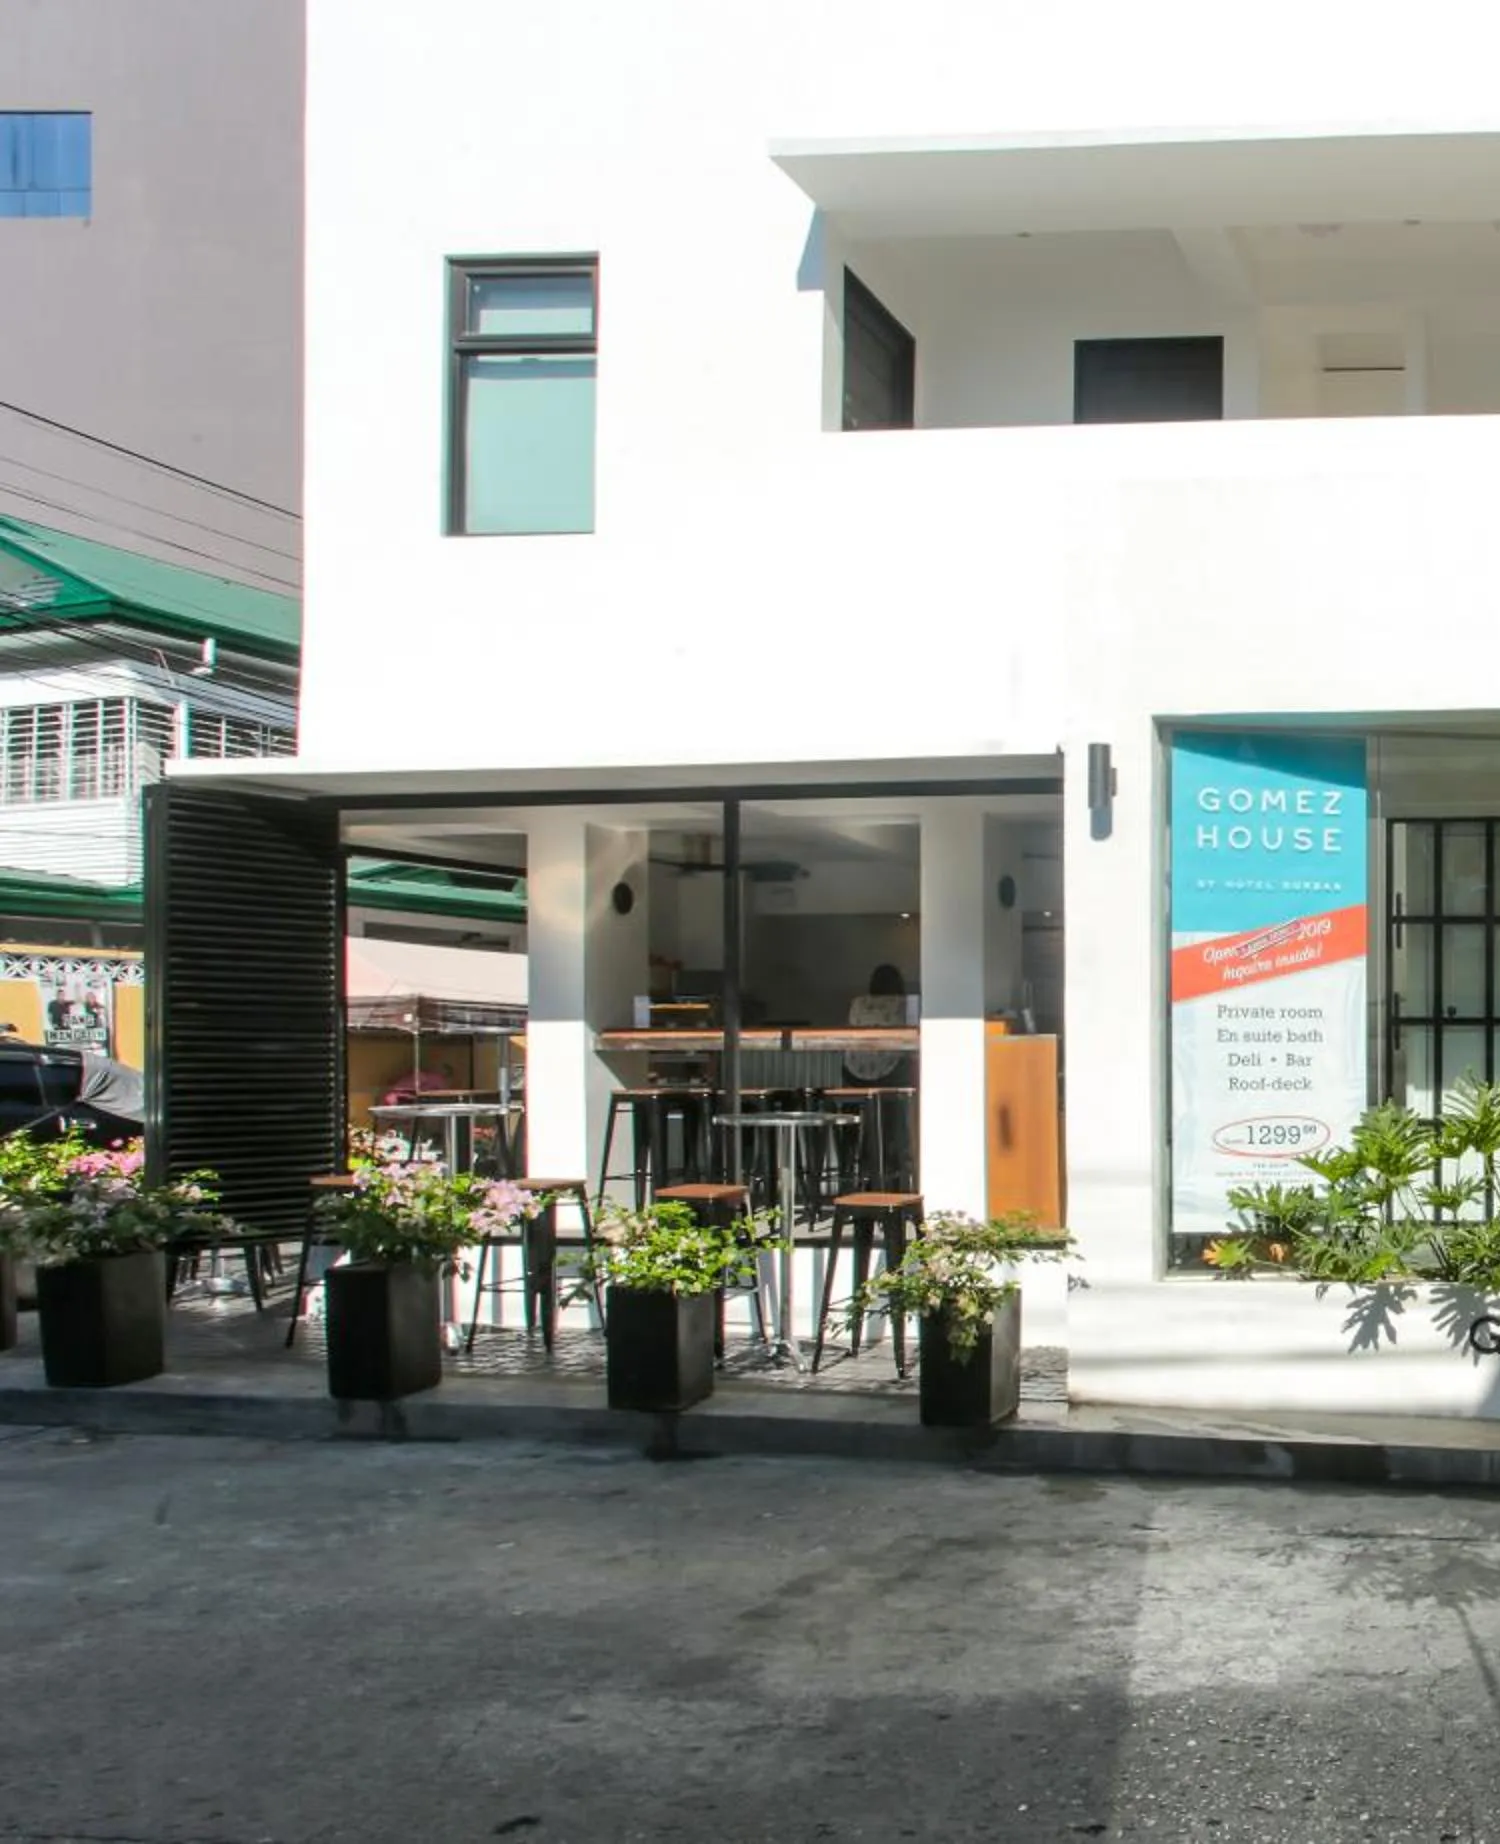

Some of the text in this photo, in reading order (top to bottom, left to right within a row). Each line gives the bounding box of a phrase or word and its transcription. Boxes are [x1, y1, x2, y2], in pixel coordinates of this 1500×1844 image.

[1198, 788, 1342, 815] GOMEZ
[1197, 825, 1342, 852] HOUSE
[1217, 1004, 1323, 1019] Private room
[1217, 1028, 1324, 1043] En suite bath
[1228, 1052, 1313, 1067] Deli Bar
[1228, 1076, 1313, 1091] Roof-deck
